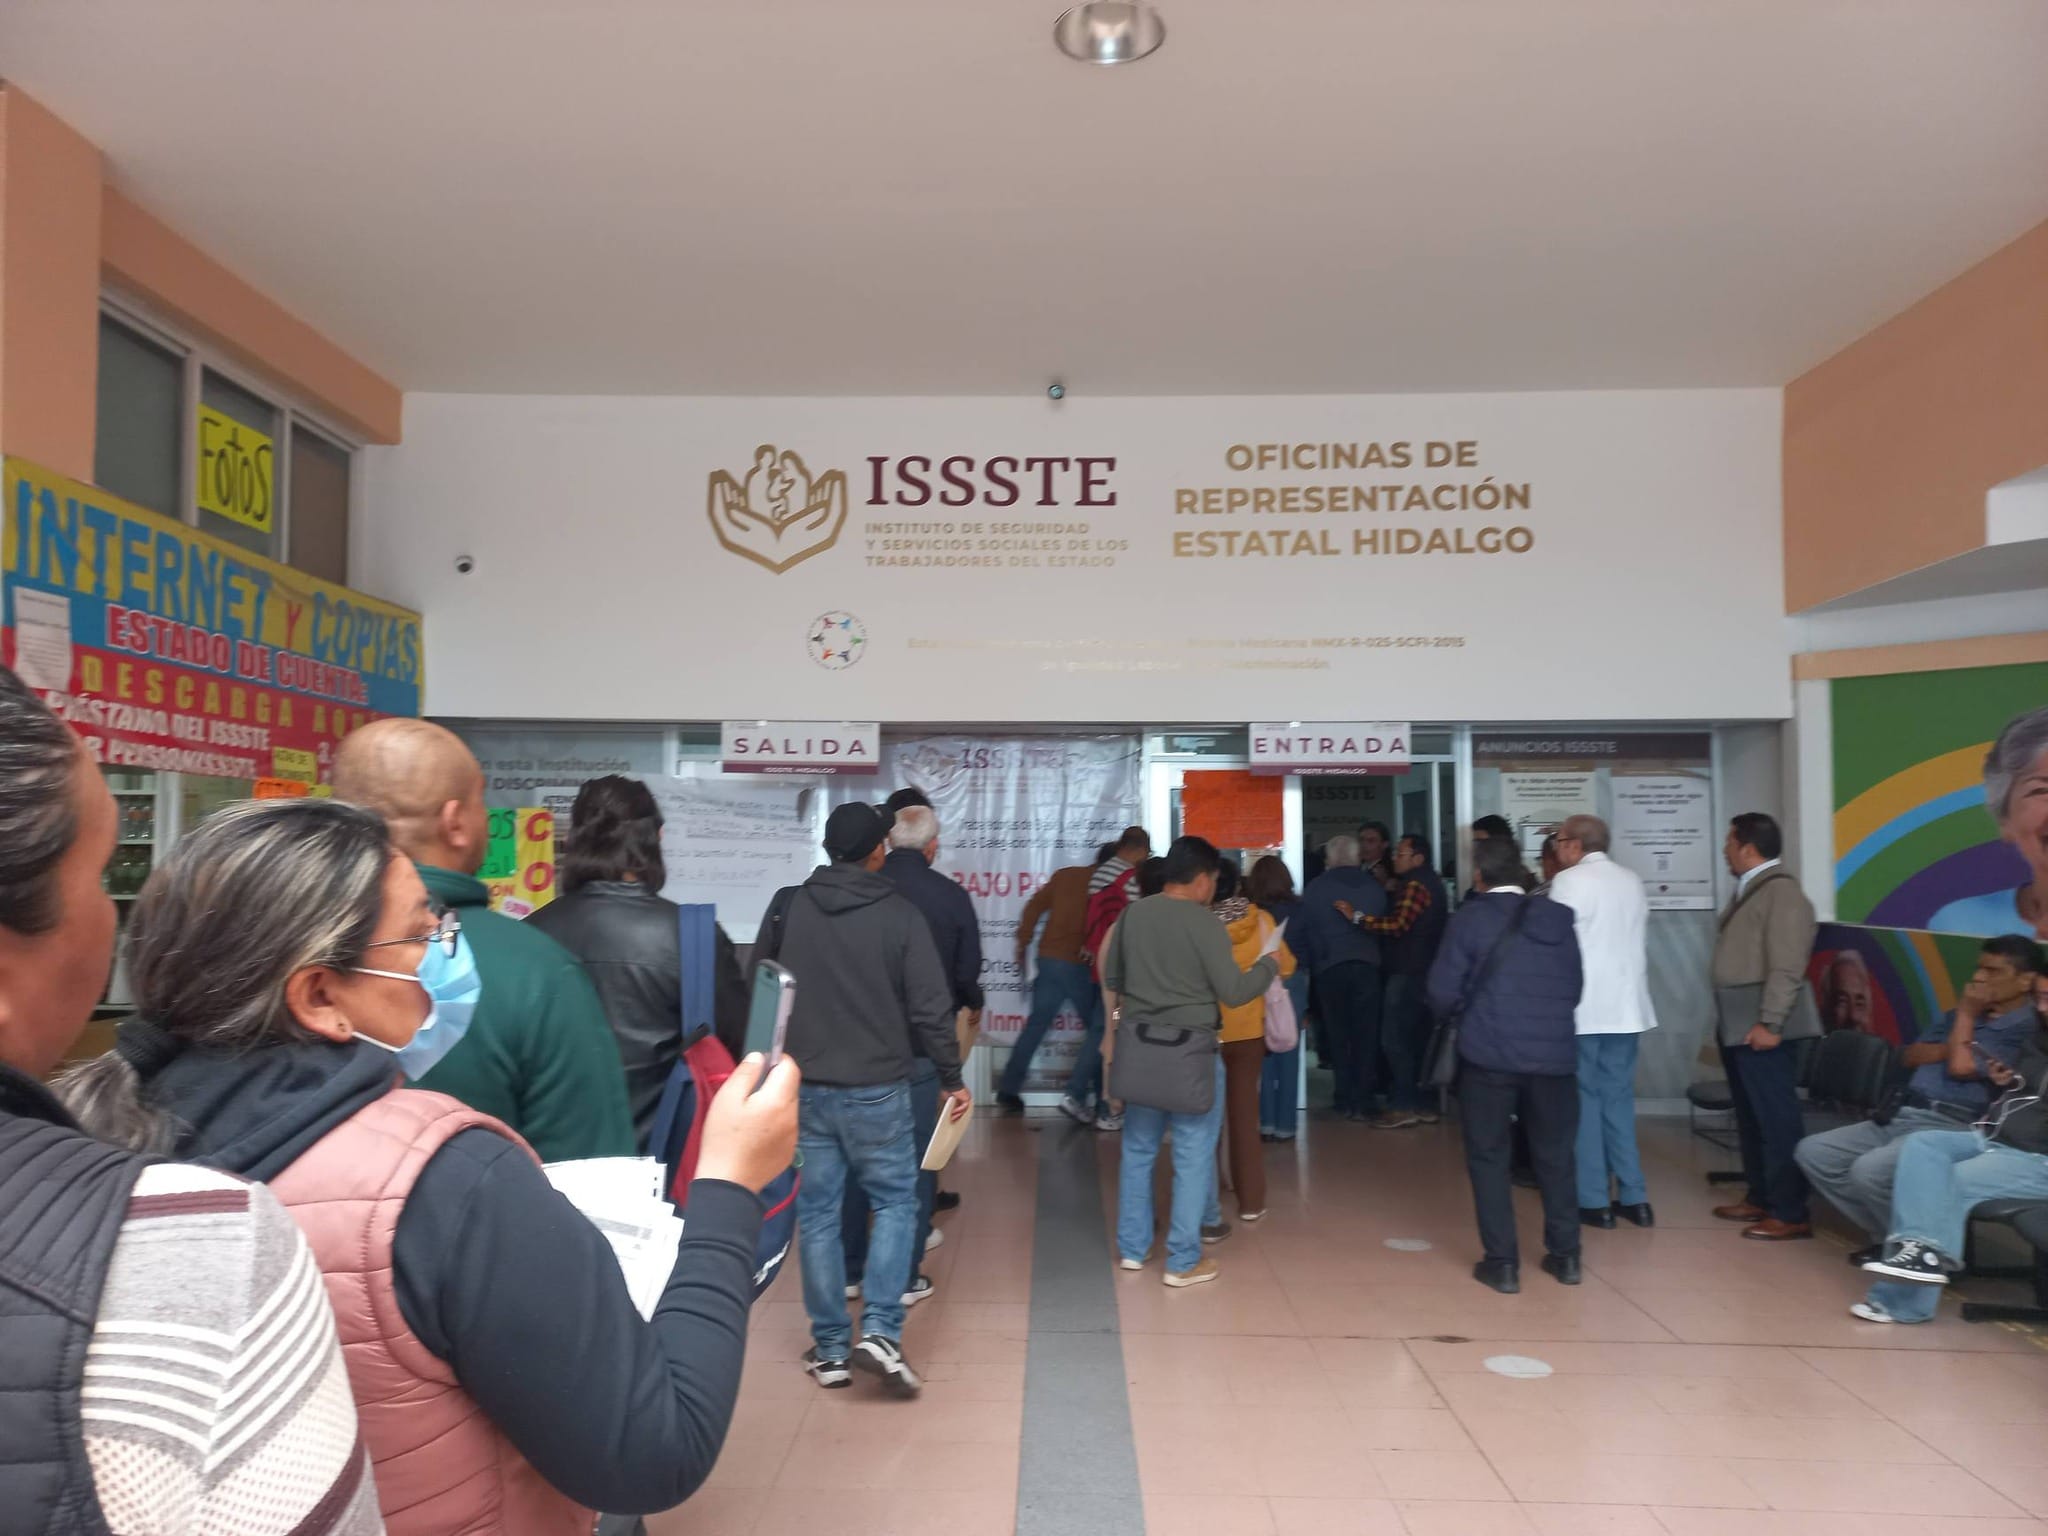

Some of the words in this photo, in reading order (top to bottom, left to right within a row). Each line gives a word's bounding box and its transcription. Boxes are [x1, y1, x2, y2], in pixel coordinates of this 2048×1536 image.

[1225, 441, 1412, 471] OFICINAS
[1425, 440, 1479, 468] DE
[865, 455, 1117, 507] ISSSTE
[1175, 477, 1532, 515] REPRESENTACIÓN
[865, 523, 955, 535] INSTITUTO
[961, 523, 984, 535] DE
[990, 523, 1090, 535] SEGURIDAD
[1172, 530, 1341, 558] ESTATAL
[1353, 526, 1536, 555] HIDALGO
[865, 539, 875, 551] Y
[882, 539, 972, 551] SERVICIOS
[978, 539, 1062, 551] SOCIALES
[1067, 539, 1091, 551] DE
[1096, 539, 1128, 551] LOS
[865, 555, 1001, 568] TRABAJADORES
[1009, 555, 1041, 568] DEL
[1047, 555, 1117, 568] ESTADO
[16, 478, 272, 645] INTERNET
[284, 600, 303, 649] Y
[310, 591, 418, 684] COPIAS
[105, 602, 232, 674] ESTADO
[236, 639, 273, 683] DE
[276, 651, 369, 706] CUENTA
[81, 655, 293, 727] DESCARGA
[171, 713, 206, 743] DEL
[208, 719, 272, 752] ISSSTE
[1254, 737, 1407, 754] ENTRADA
[734, 738, 866, 755] SALIDA
[1478, 741, 1561, 753] ANUNCIOS
[1564, 741, 1618, 753] ISSSTE
[980, 957, 1022, 979] Orteg
[987, 1010, 1086, 1032] Inmata
